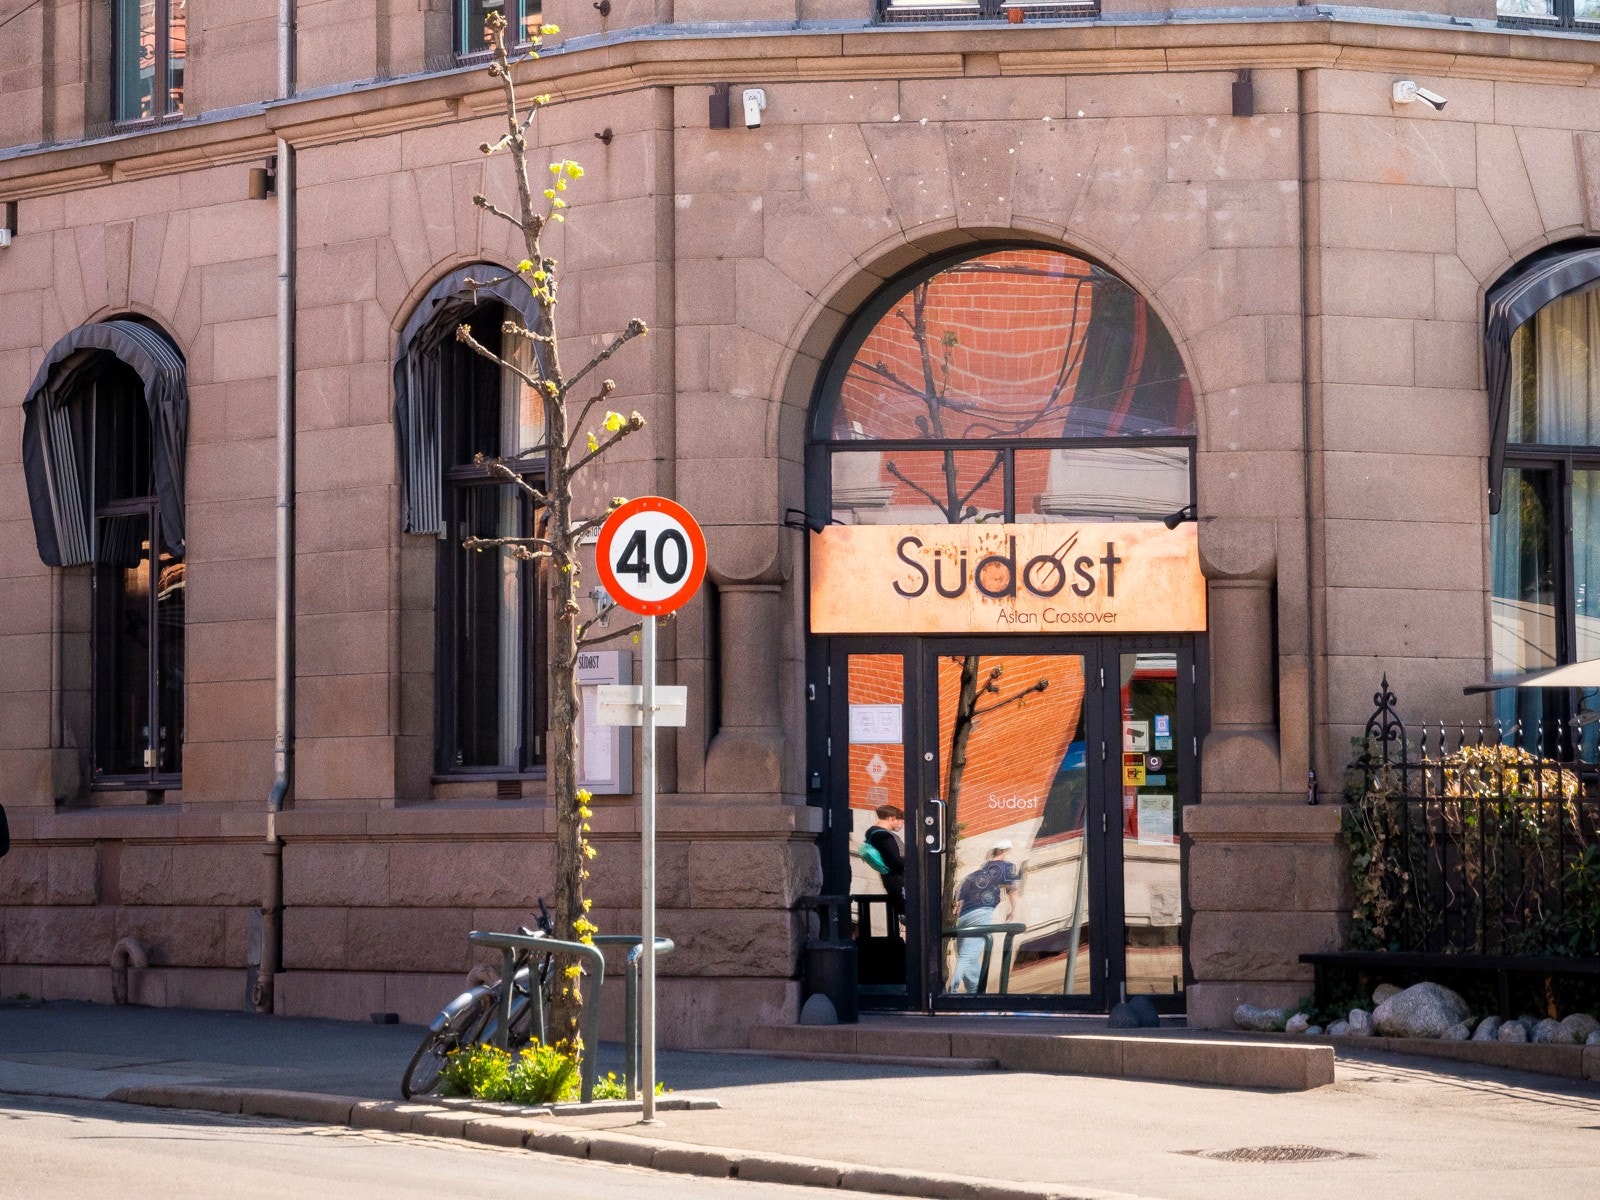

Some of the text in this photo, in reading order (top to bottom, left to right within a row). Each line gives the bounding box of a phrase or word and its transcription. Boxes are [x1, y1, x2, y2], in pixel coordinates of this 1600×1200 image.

[616, 528, 688, 584] 40
[997, 608, 1118, 624] Asian Crossover
